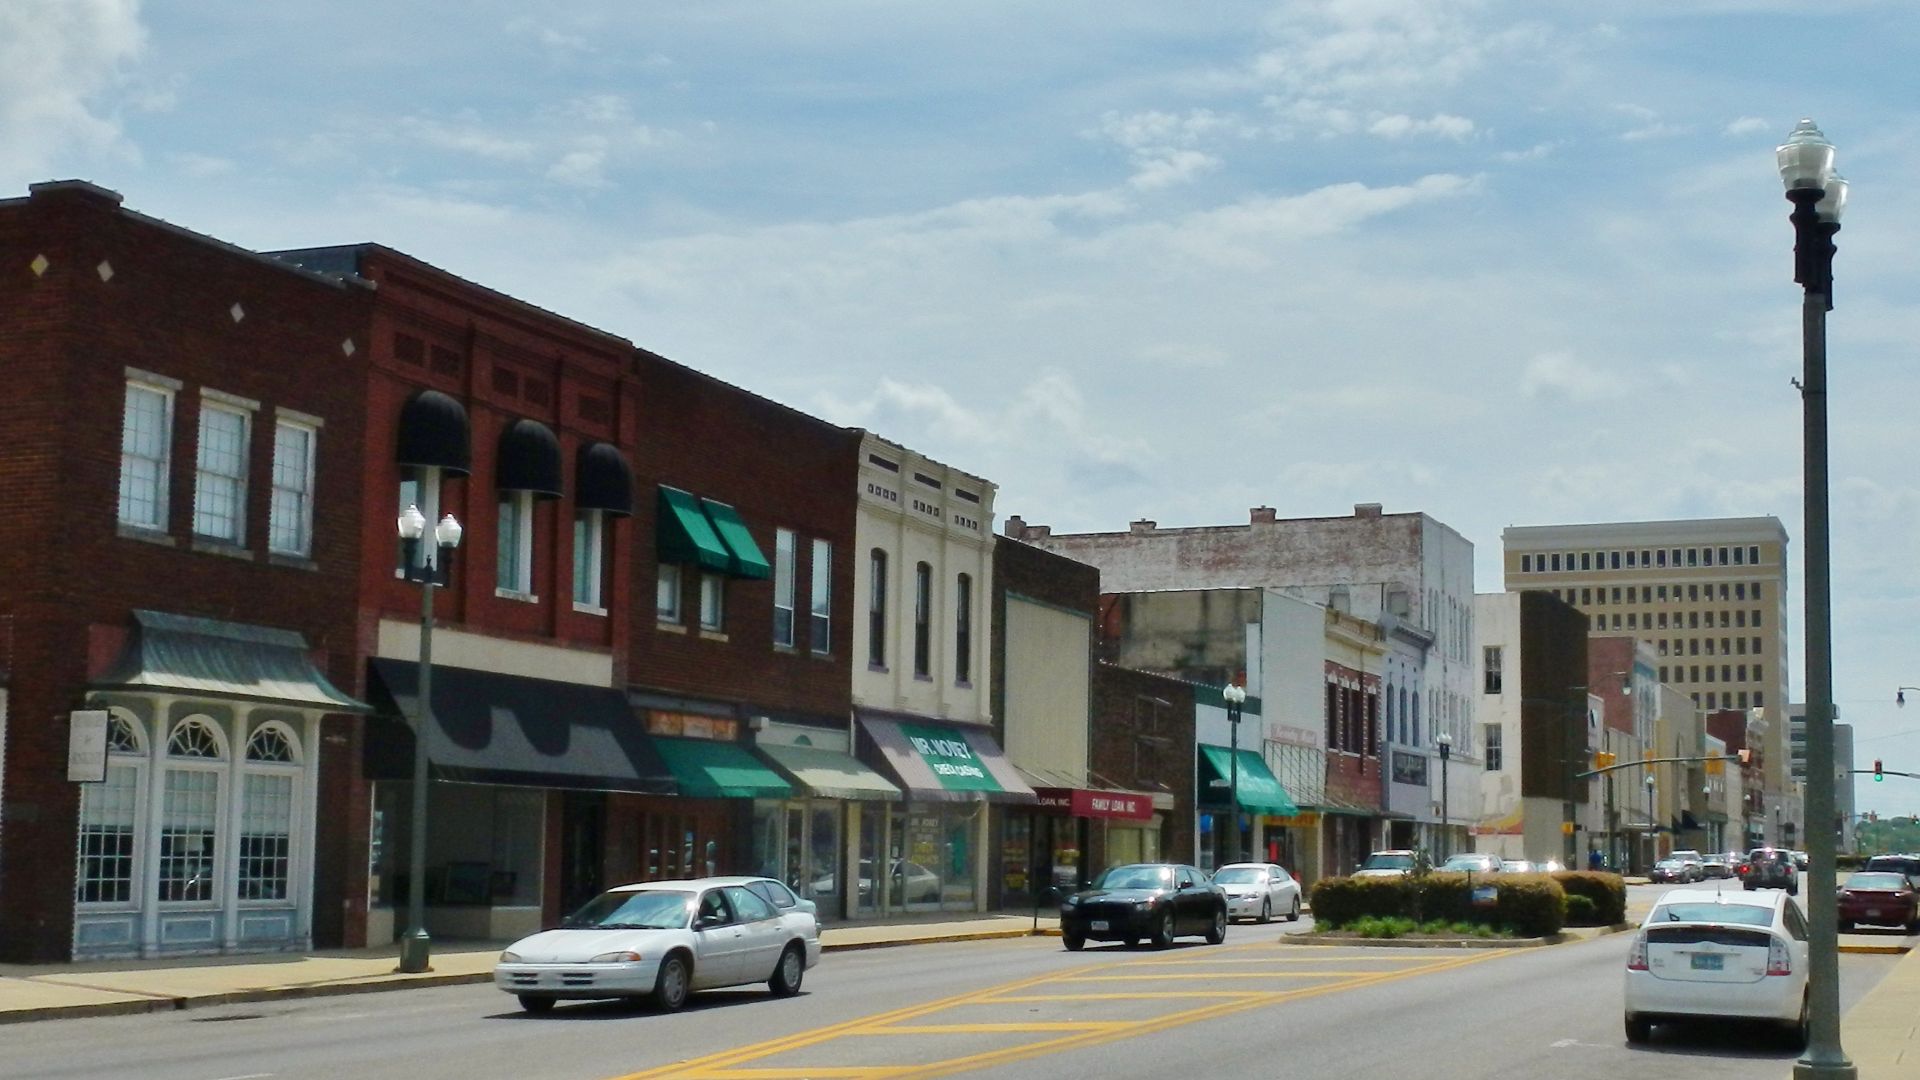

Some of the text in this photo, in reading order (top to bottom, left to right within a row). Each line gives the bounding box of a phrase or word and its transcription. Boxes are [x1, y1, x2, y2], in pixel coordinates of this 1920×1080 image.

[910, 736, 972, 759] MR. MONEY
[1092, 798, 1110, 811] FAMILY
